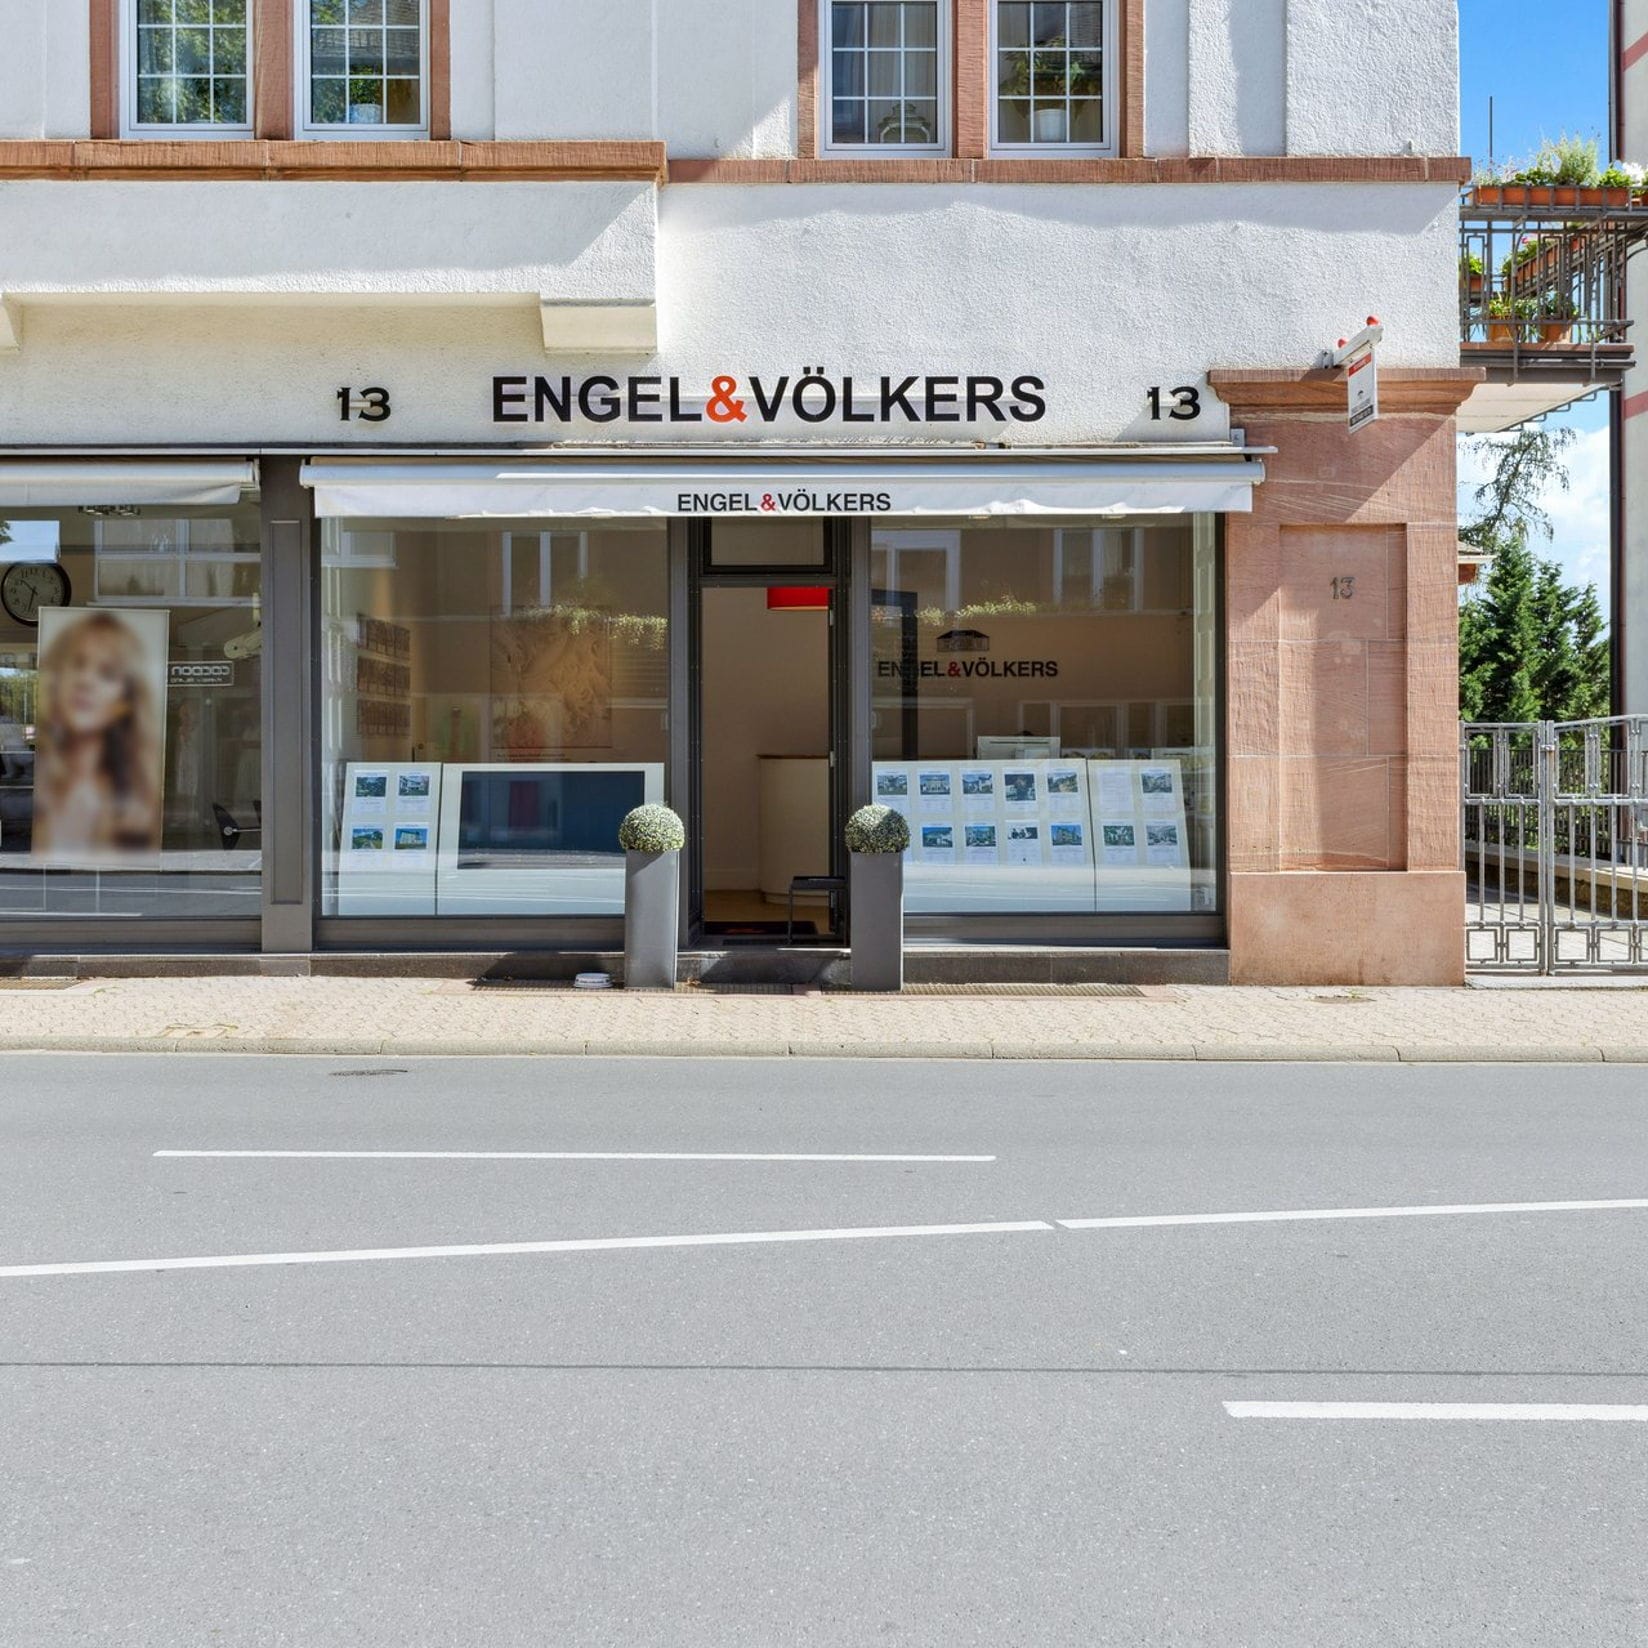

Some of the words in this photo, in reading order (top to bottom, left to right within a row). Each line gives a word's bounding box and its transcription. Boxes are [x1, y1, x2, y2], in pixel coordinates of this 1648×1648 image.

[337, 387, 391, 422] 13
[492, 367, 1046, 423] ENGEL&VÖLKERS
[1147, 386, 1201, 421] 13
[677, 489, 891, 512] ENGEL&VÖLKERS
[1329, 576, 1356, 600] 13
[877, 657, 1058, 677] ENEL&VÖLKERS
